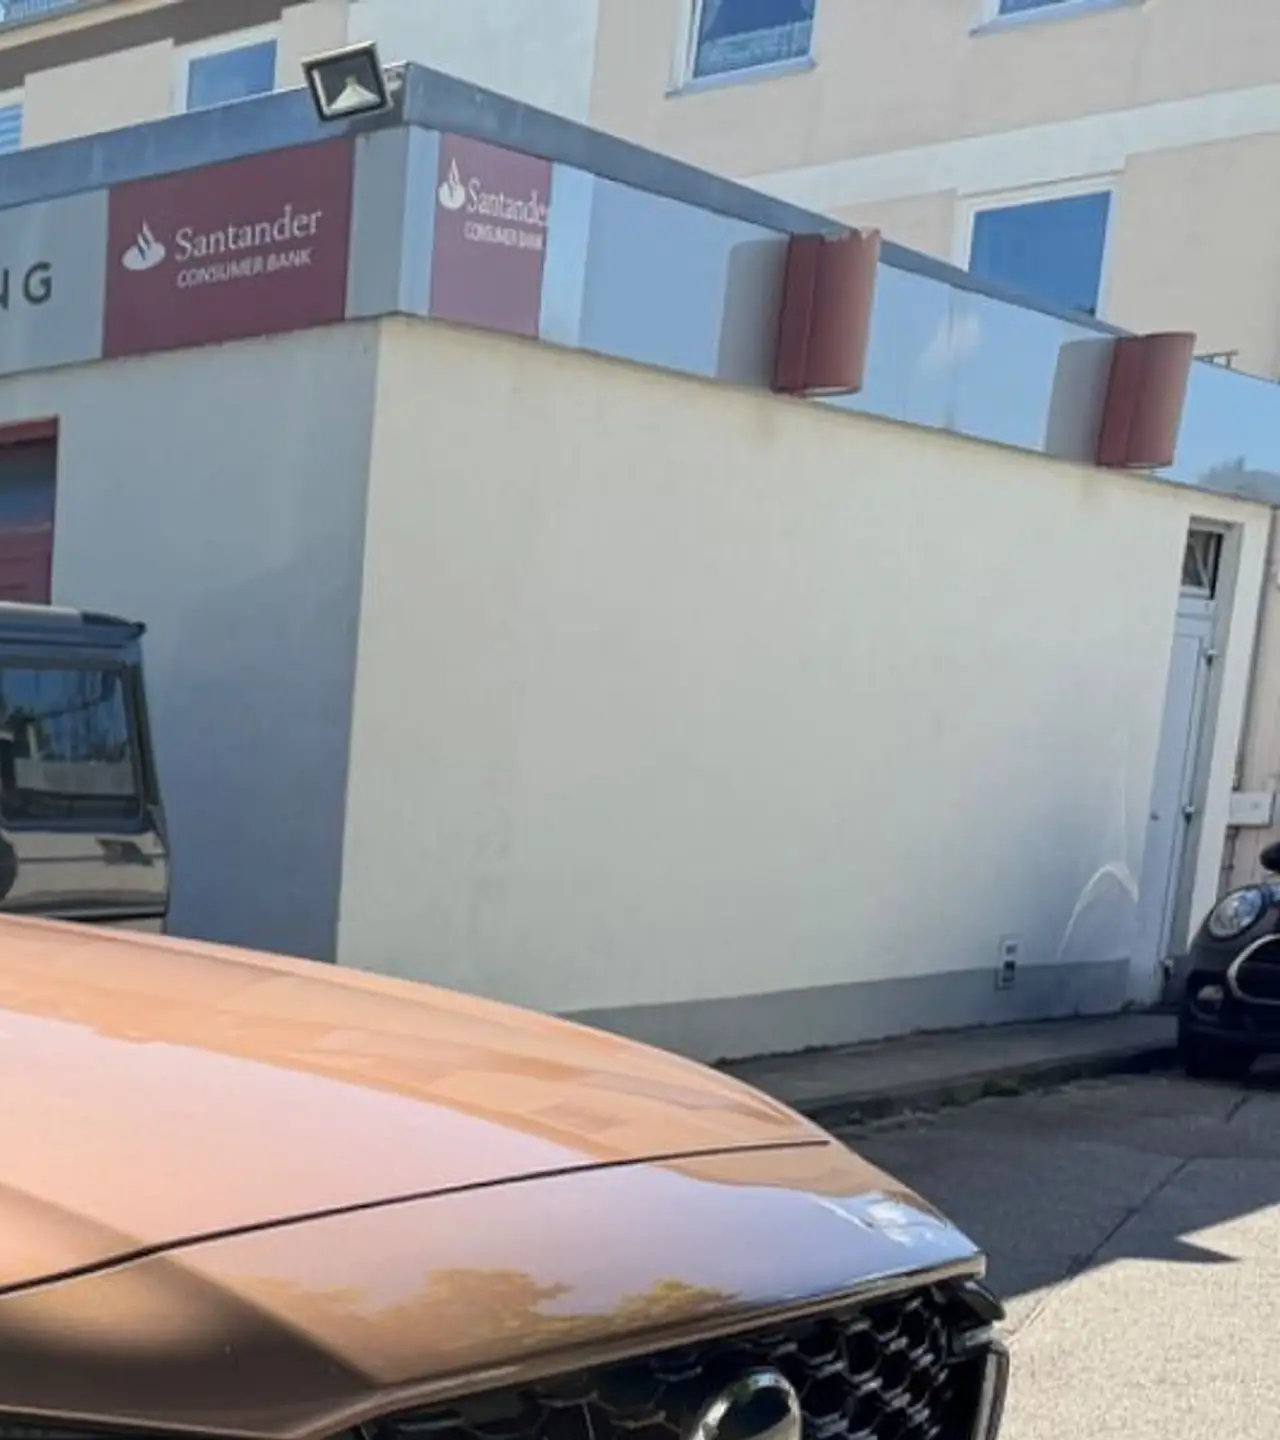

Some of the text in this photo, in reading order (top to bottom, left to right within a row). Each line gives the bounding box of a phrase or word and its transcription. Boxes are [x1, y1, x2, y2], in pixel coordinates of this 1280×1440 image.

[174, 202, 323, 263] Santander
[176, 247, 313, 289] CONSUMER BANK
